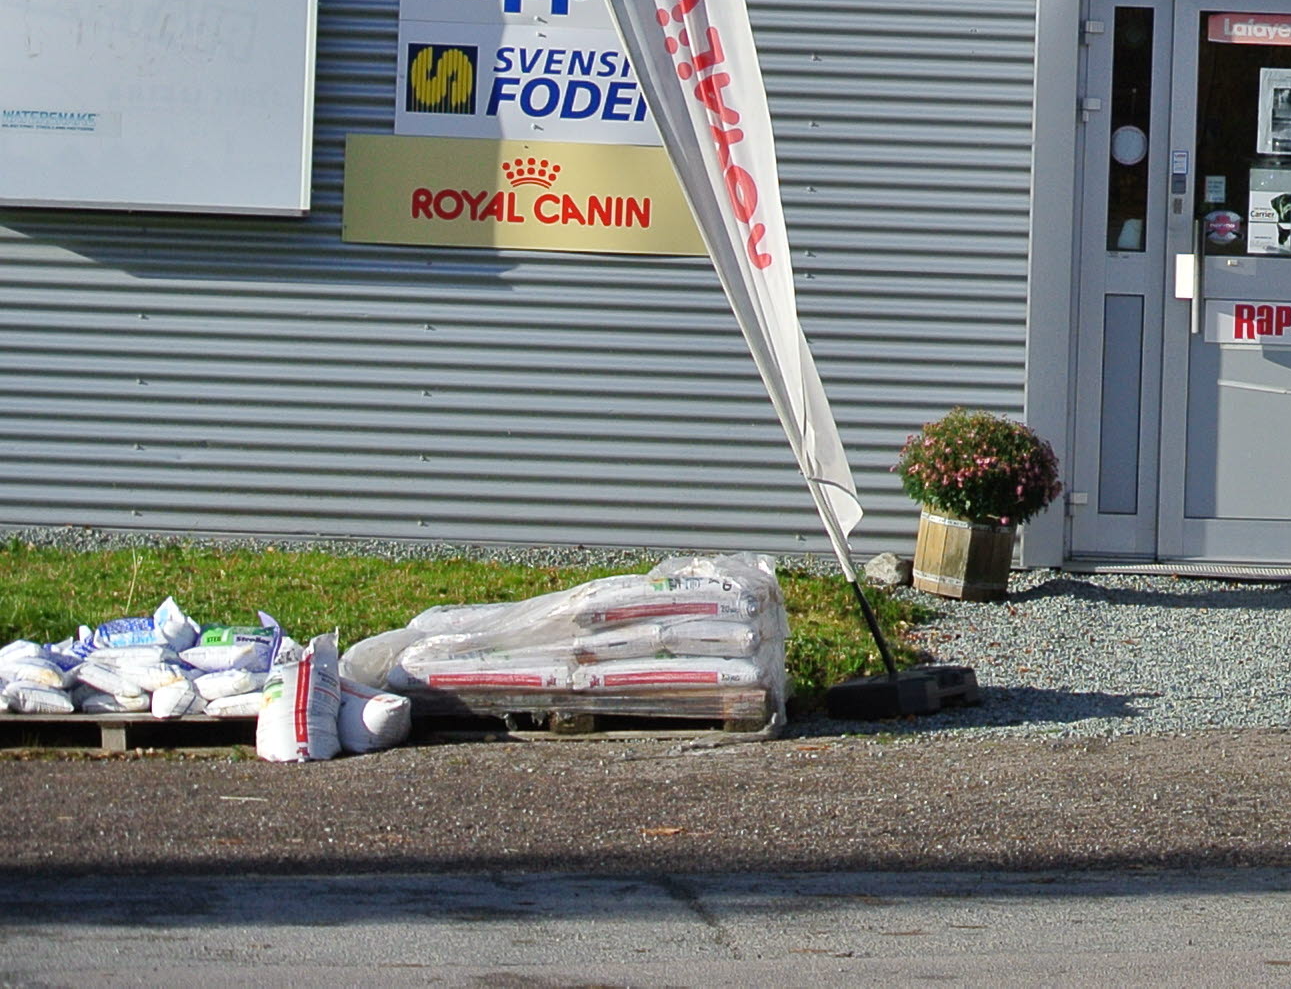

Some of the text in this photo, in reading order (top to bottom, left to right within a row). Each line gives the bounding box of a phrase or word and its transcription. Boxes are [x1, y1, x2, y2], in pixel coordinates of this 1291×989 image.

[493, 46, 633, 77] SVENS
[411, 187, 651, 228] ROYAL CANIN
